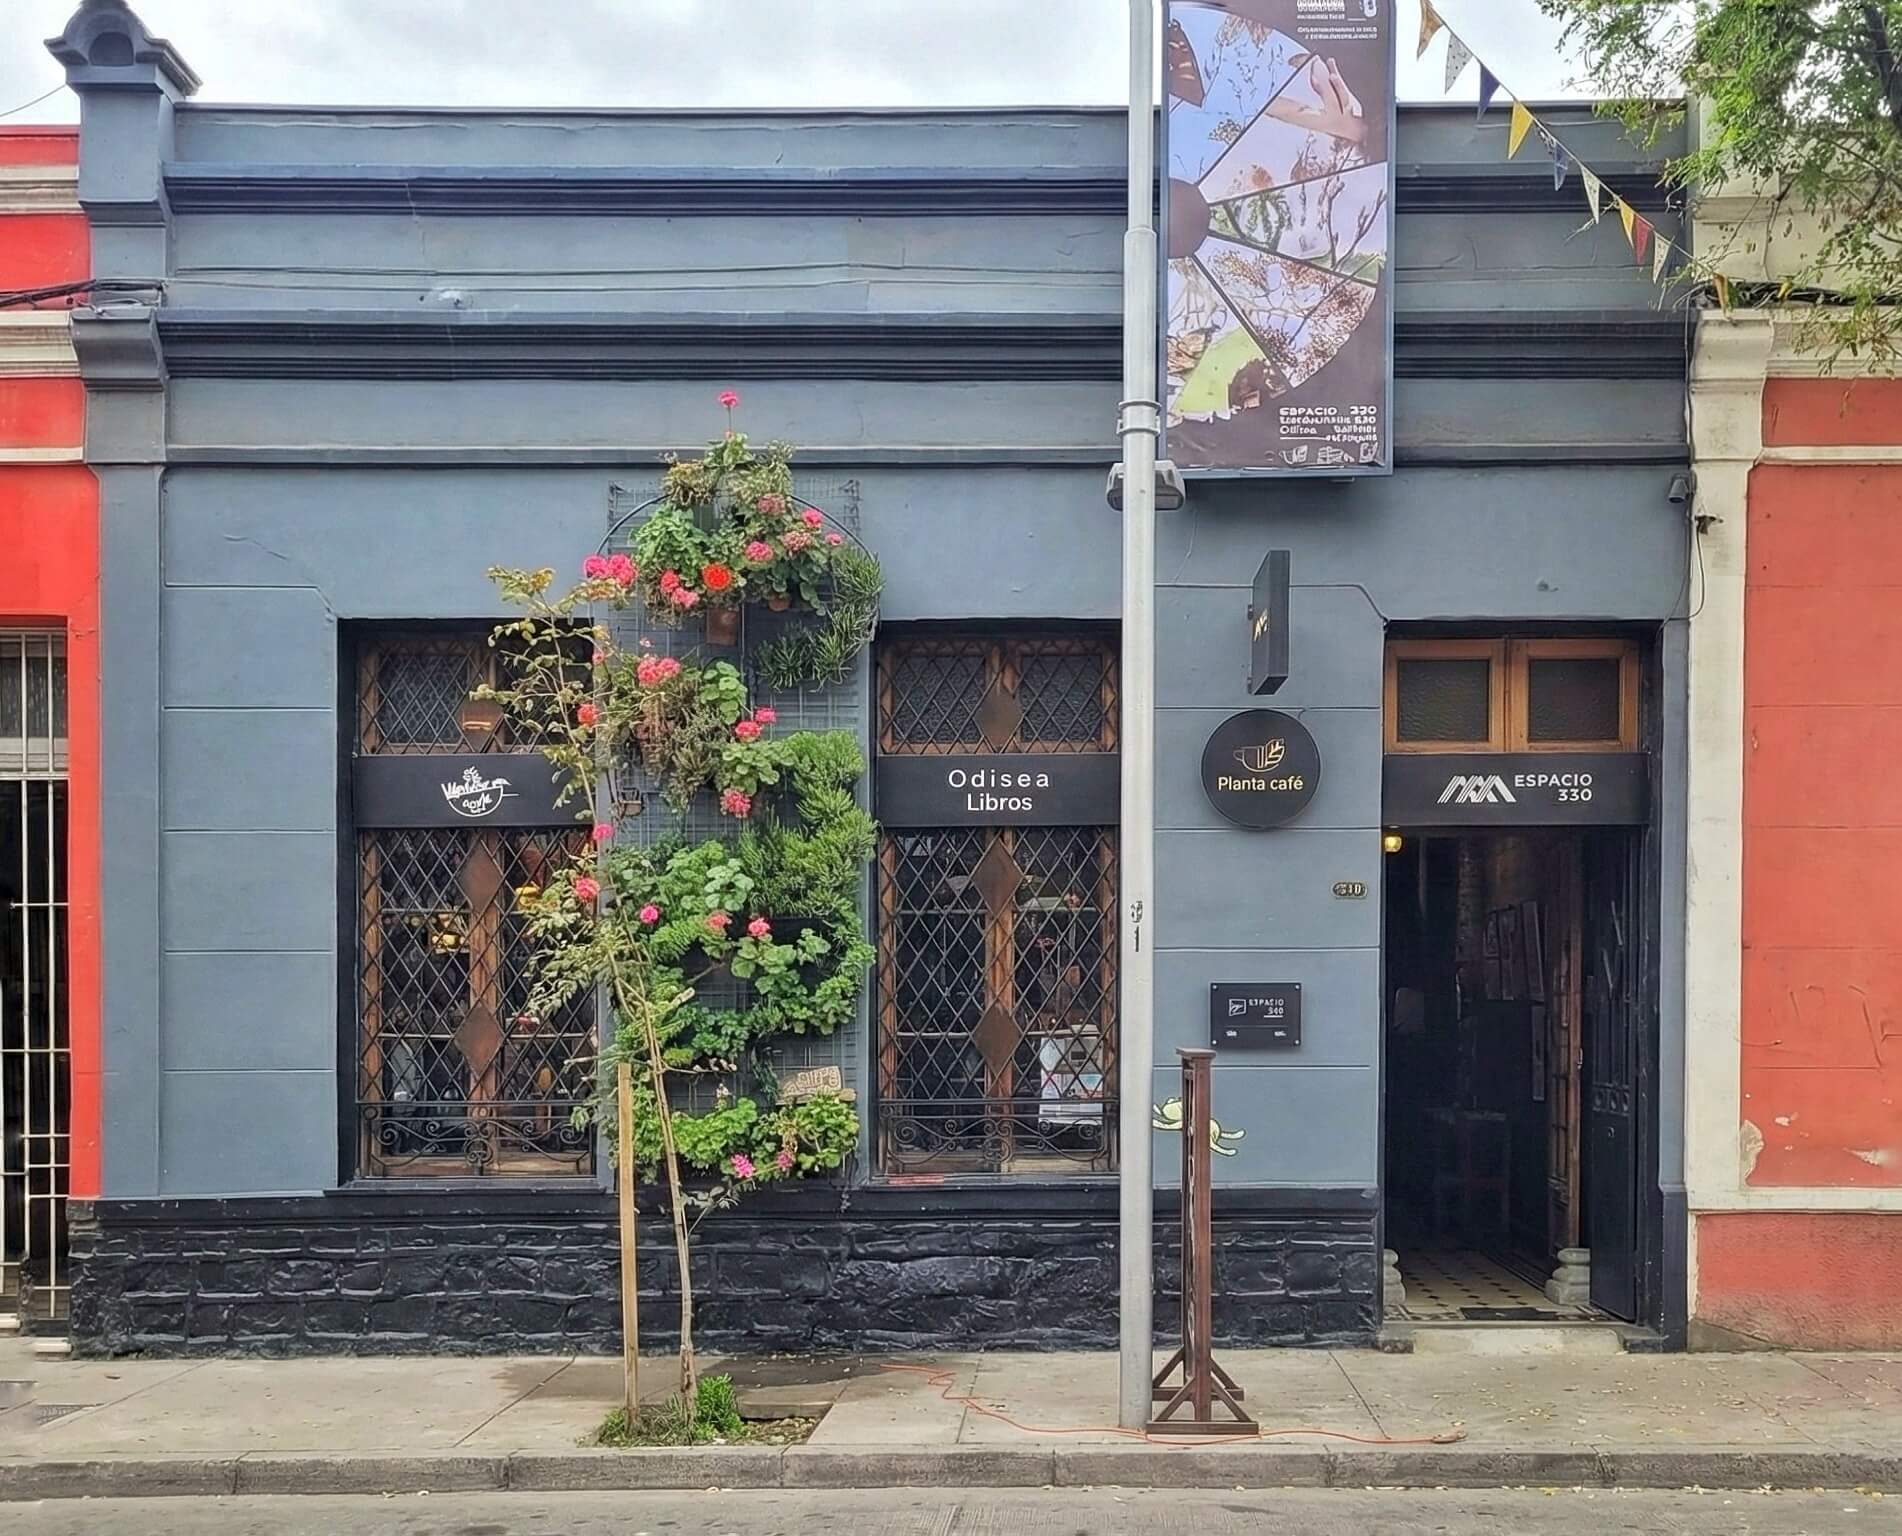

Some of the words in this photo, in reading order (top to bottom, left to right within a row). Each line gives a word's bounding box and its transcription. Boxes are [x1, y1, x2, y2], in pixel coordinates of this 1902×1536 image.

[948, 768, 1049, 788] Odisea
[1218, 775, 1266, 791] Planta
[1269, 775, 1304, 791] café
[1514, 773, 1593, 787] ESPACIO
[967, 792, 1033, 812] Libros
[1558, 788, 1593, 802] 330
